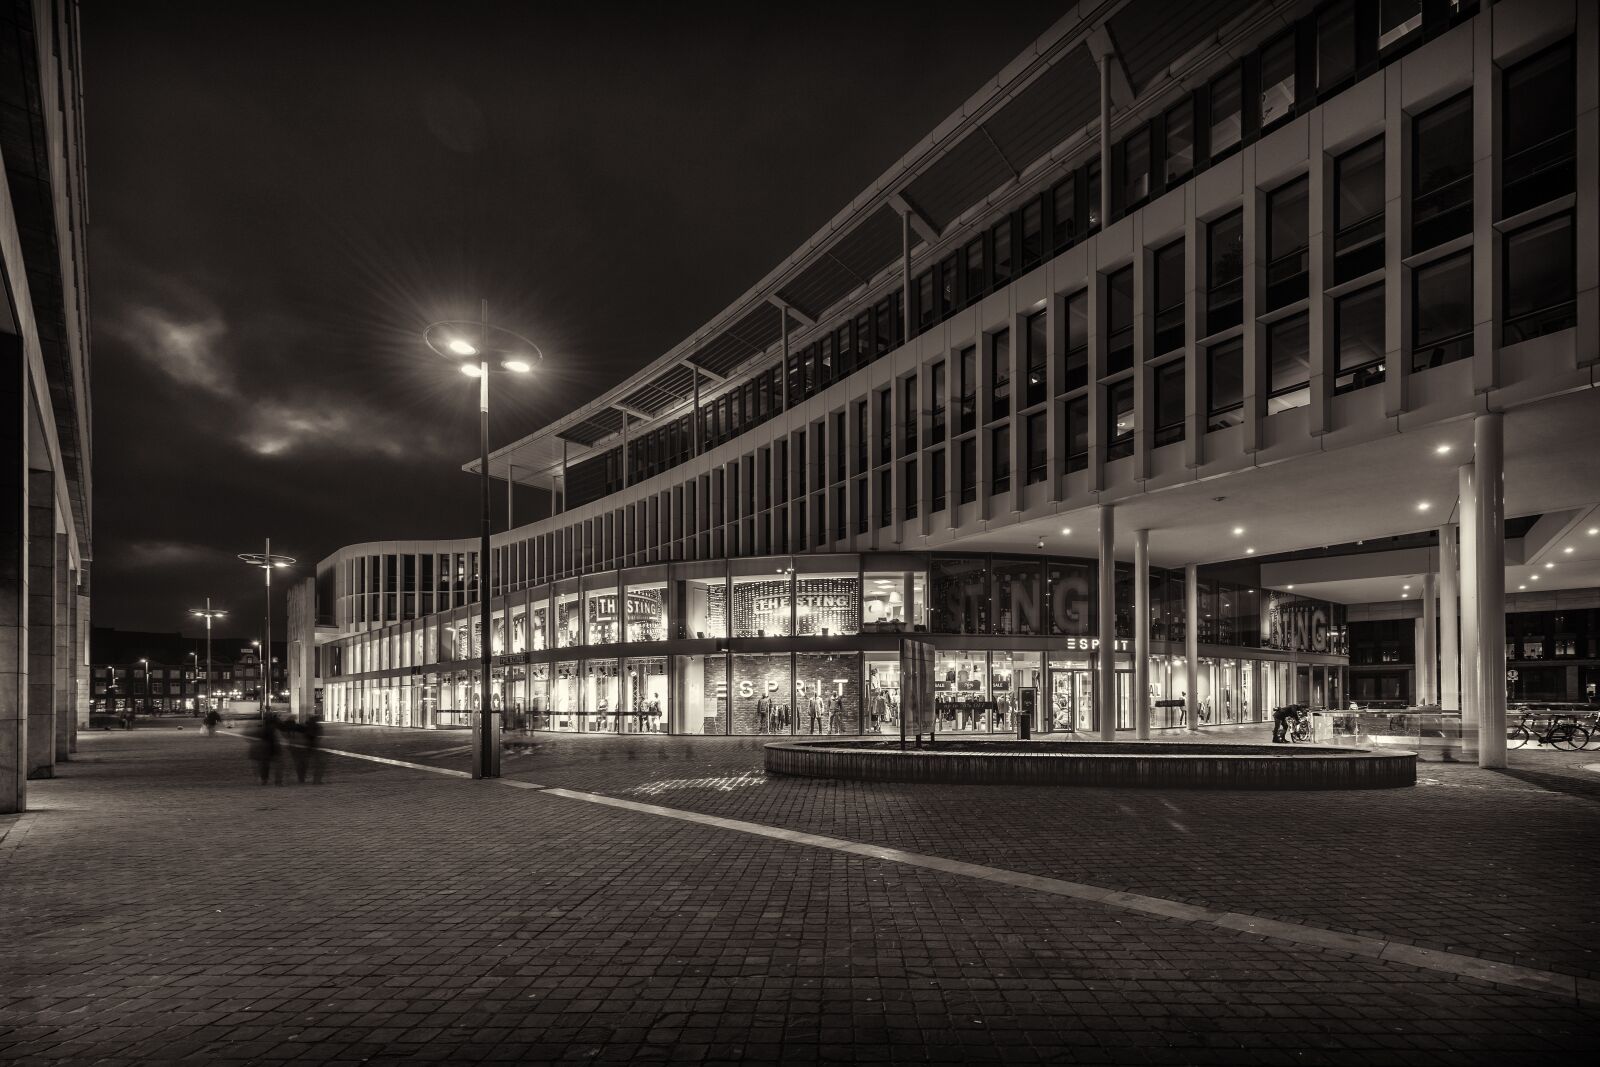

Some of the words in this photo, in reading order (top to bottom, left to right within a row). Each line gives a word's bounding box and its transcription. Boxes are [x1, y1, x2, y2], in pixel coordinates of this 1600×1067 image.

[600, 599, 616, 614] TH
[627, 599, 656, 615] STING
[796, 596, 847, 607] STING
[1067, 638, 1128, 651] ESPIT
[716, 679, 848, 698] ESPRIT
